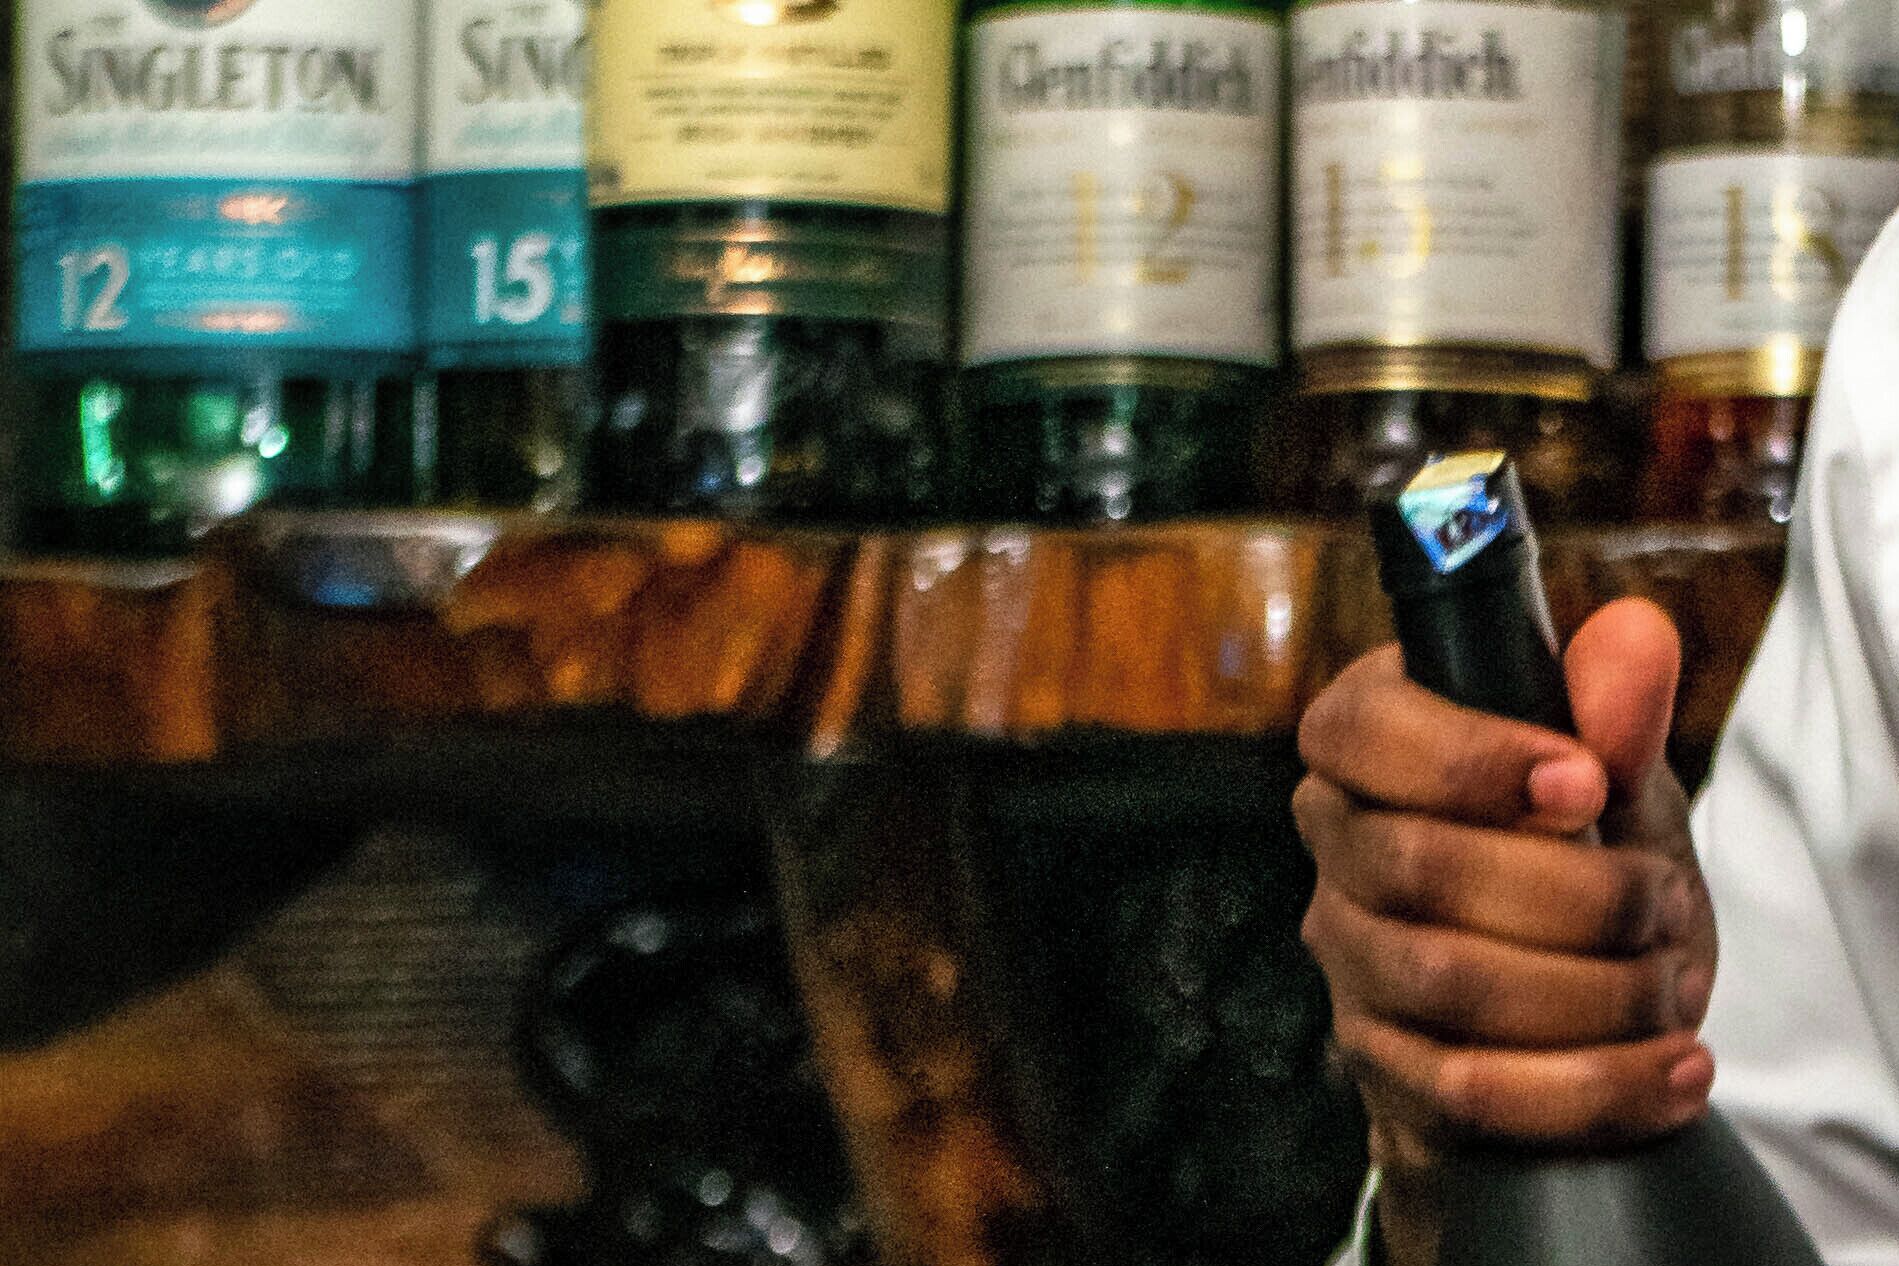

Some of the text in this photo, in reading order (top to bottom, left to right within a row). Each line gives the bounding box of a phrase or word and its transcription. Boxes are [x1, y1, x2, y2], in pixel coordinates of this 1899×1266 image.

[1070, 169, 1197, 285] 12
[57, 243, 131, 332] 12
[470, 231, 558, 324] 15
